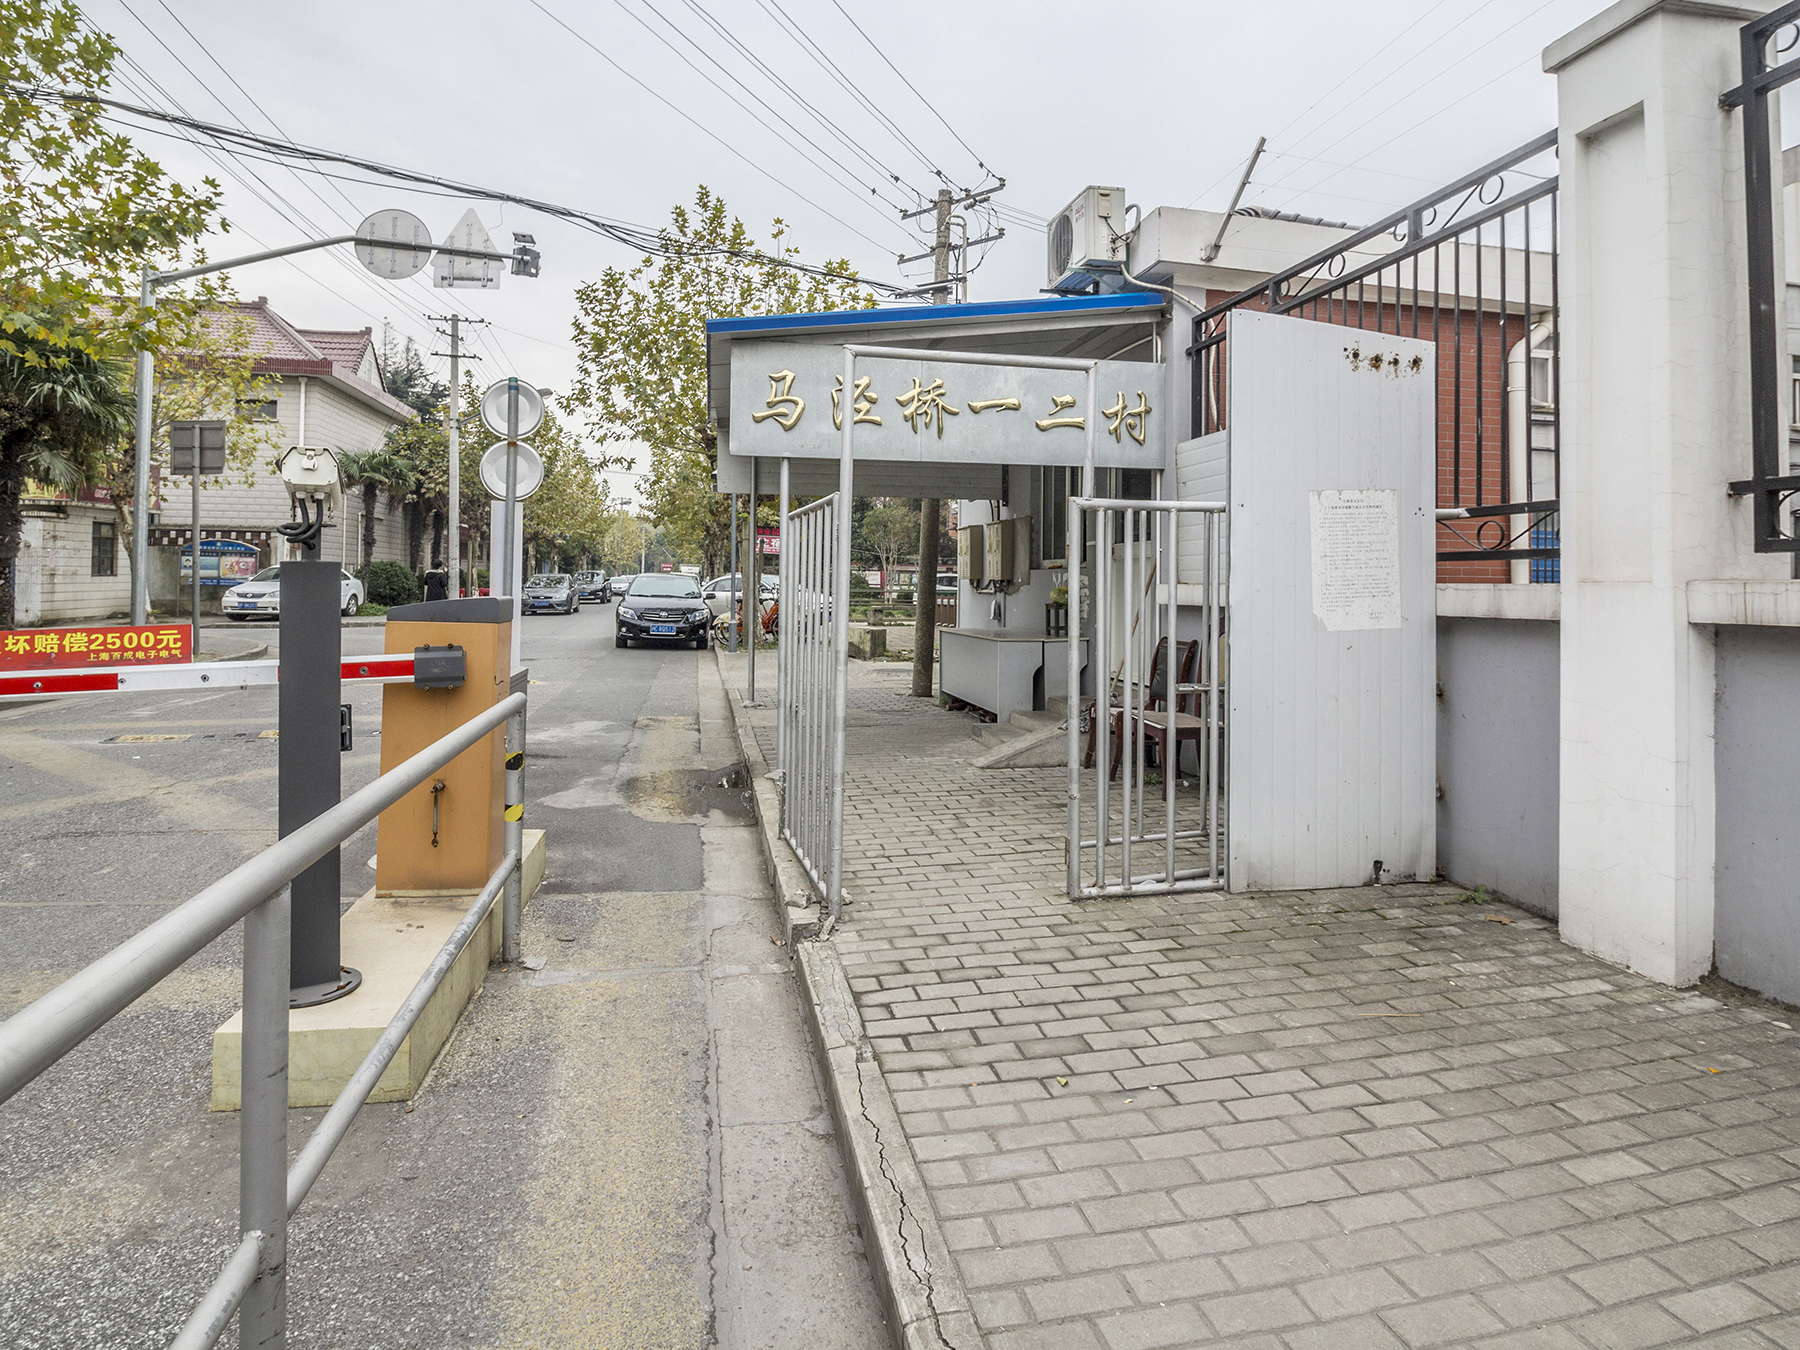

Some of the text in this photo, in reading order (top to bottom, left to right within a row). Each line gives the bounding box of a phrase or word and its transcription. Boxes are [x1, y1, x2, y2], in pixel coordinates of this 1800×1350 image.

[752, 369, 1151, 446] 马泾桥一二村
[0, 630, 182, 655] 坏赔偿2500元
